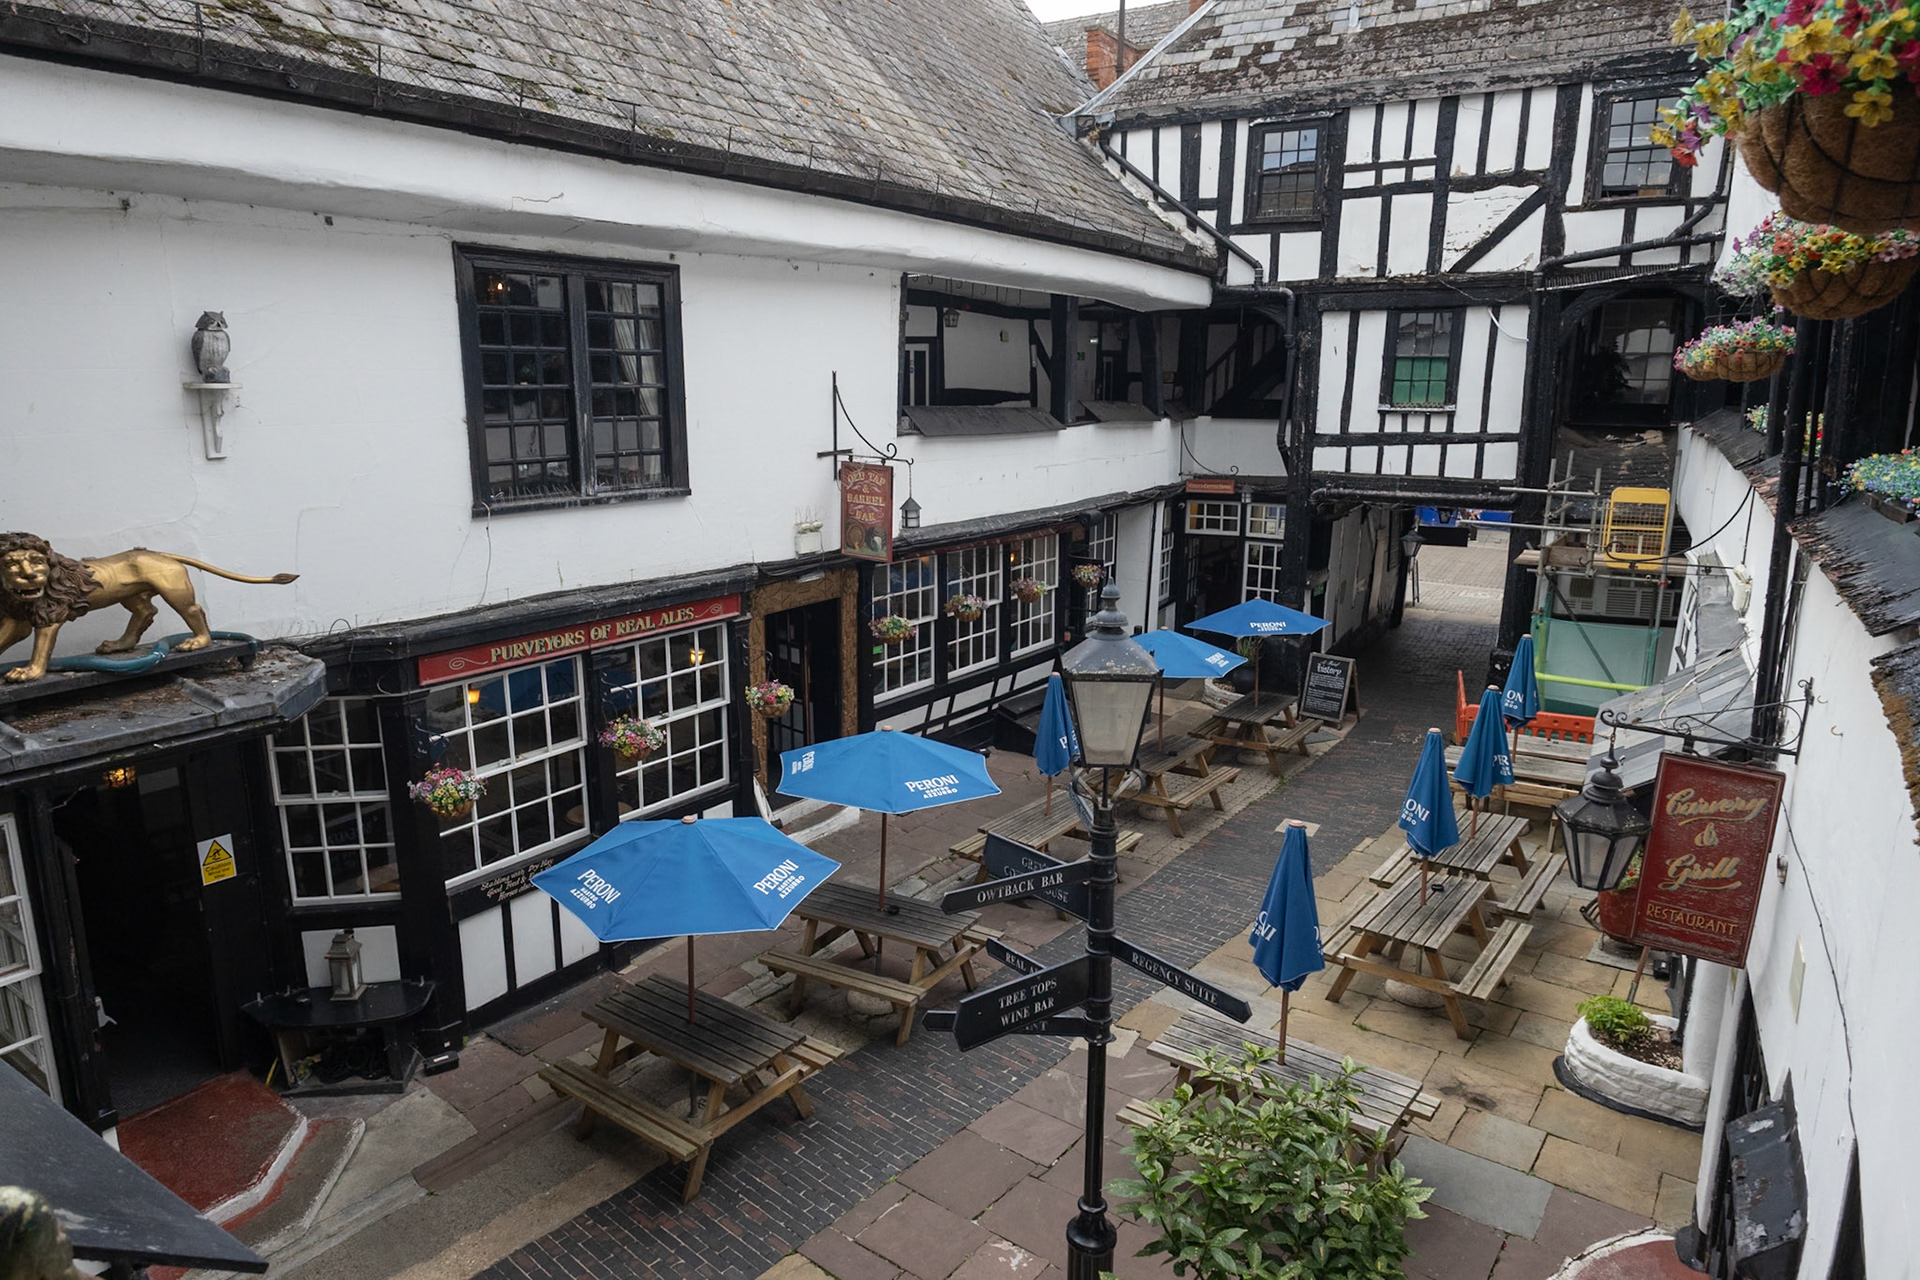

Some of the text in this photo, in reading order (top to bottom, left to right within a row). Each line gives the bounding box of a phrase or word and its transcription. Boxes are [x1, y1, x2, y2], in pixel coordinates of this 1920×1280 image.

[862, 484, 870, 494] &
[868, 472, 886, 486] TAP
[846, 493, 885, 506] BARREL
[856, 510, 876, 521] BAR
[490, 606, 696, 665] PURVEYORS OF REAL ALES
[1249, 621, 1287, 629] PERONI
[904, 774, 960, 793] PERONI
[1665, 787, 1769, 826] Carvery
[1694, 822, 1719, 847] &
[206, 861, 231, 872] Caution
[752, 858, 799, 896] PERONI
[1658, 853, 1742, 891] Grill
[570, 888, 597, 909] AZZURRO
[577, 869, 621, 905] PERONI
[779, 875, 806, 899] AZZURRO
[977, 878, 1035, 903] OWTBACK
[1041, 872, 1064, 888] BAR
[1646, 903, 1738, 936] RESTAURANT
[1005, 952, 1027, 972] REAL
[1131, 951, 1219, 1006] REGENCY SUITE
[999, 977, 1058, 1009] TREE TOPS
[1000, 1004, 1031, 1027] WINE
[1034, 997, 1056, 1015] BAR
